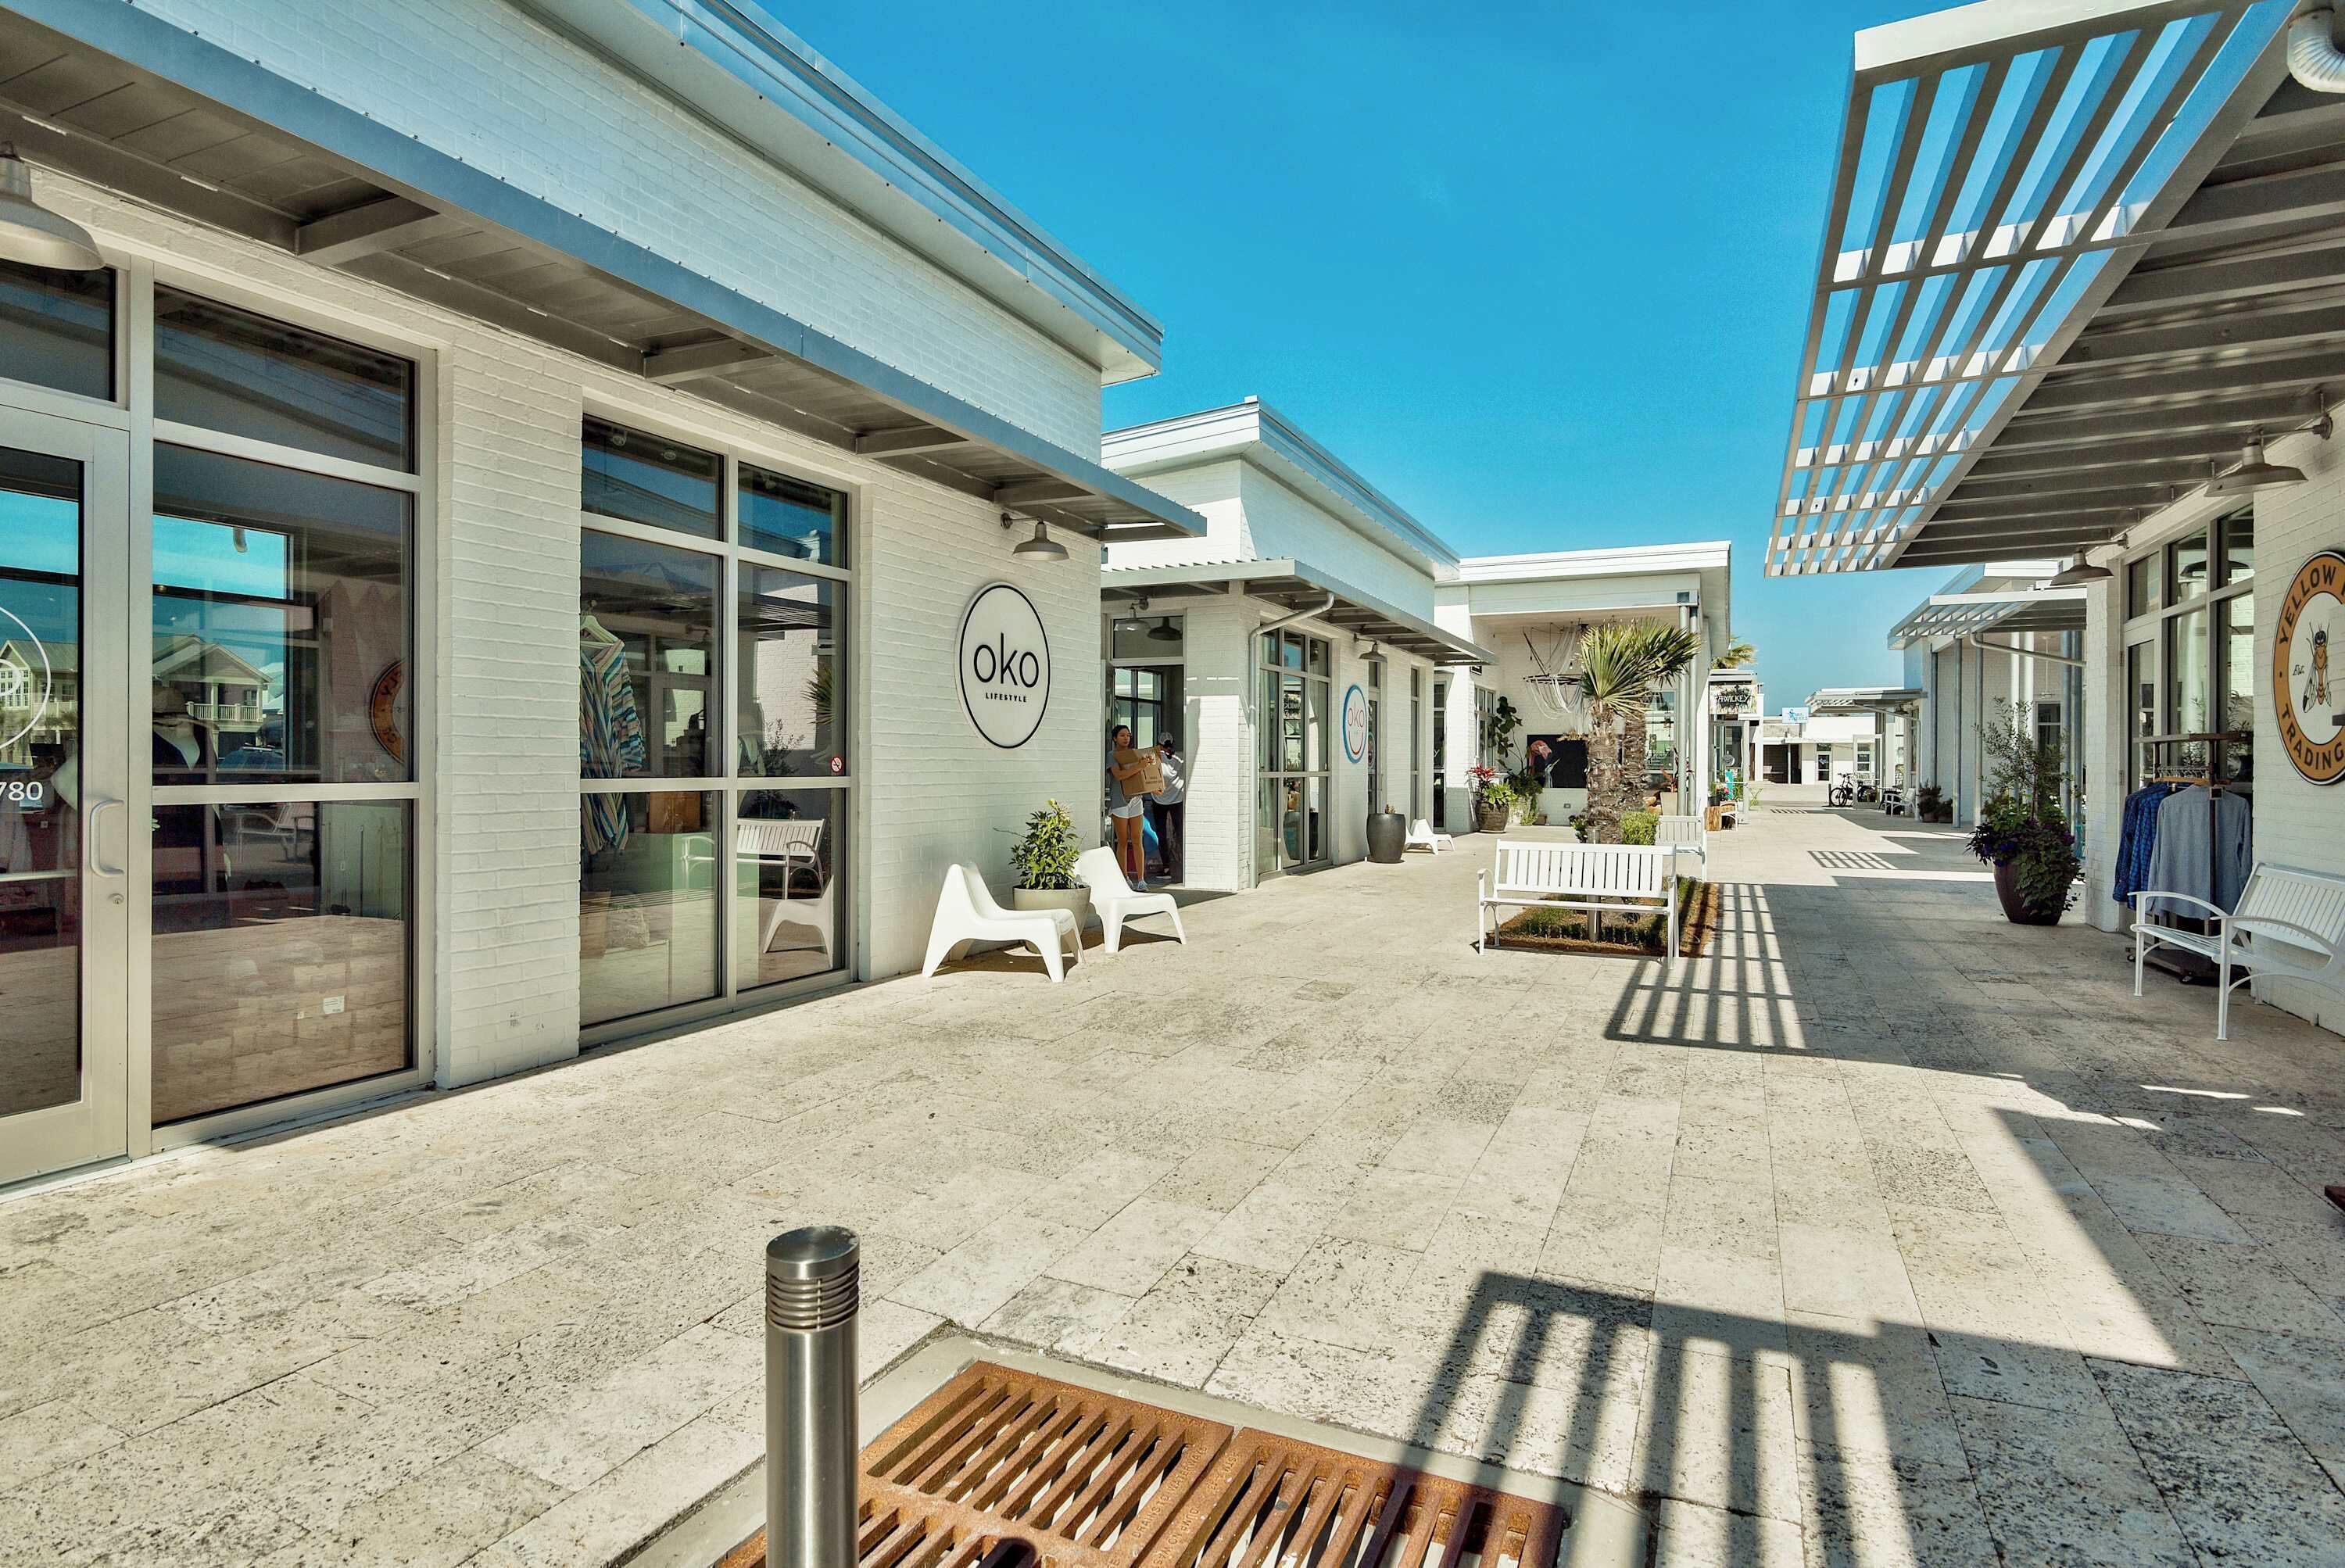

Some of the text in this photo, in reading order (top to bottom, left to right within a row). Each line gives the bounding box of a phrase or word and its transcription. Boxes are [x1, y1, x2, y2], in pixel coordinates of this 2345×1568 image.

[2279, 564, 2336, 643] YELLOW
[974, 632, 1039, 688] oko
[986, 693, 1027, 703] LIFESTYLE
[1348, 700, 1364, 728] oko
[2282, 703, 2344, 770] TRADING
[1131, 1505, 1162, 1538] DRAINS
[1168, 1445, 1208, 1492] WATERWAYS
[1153, 1547, 1172, 1568] WAS
